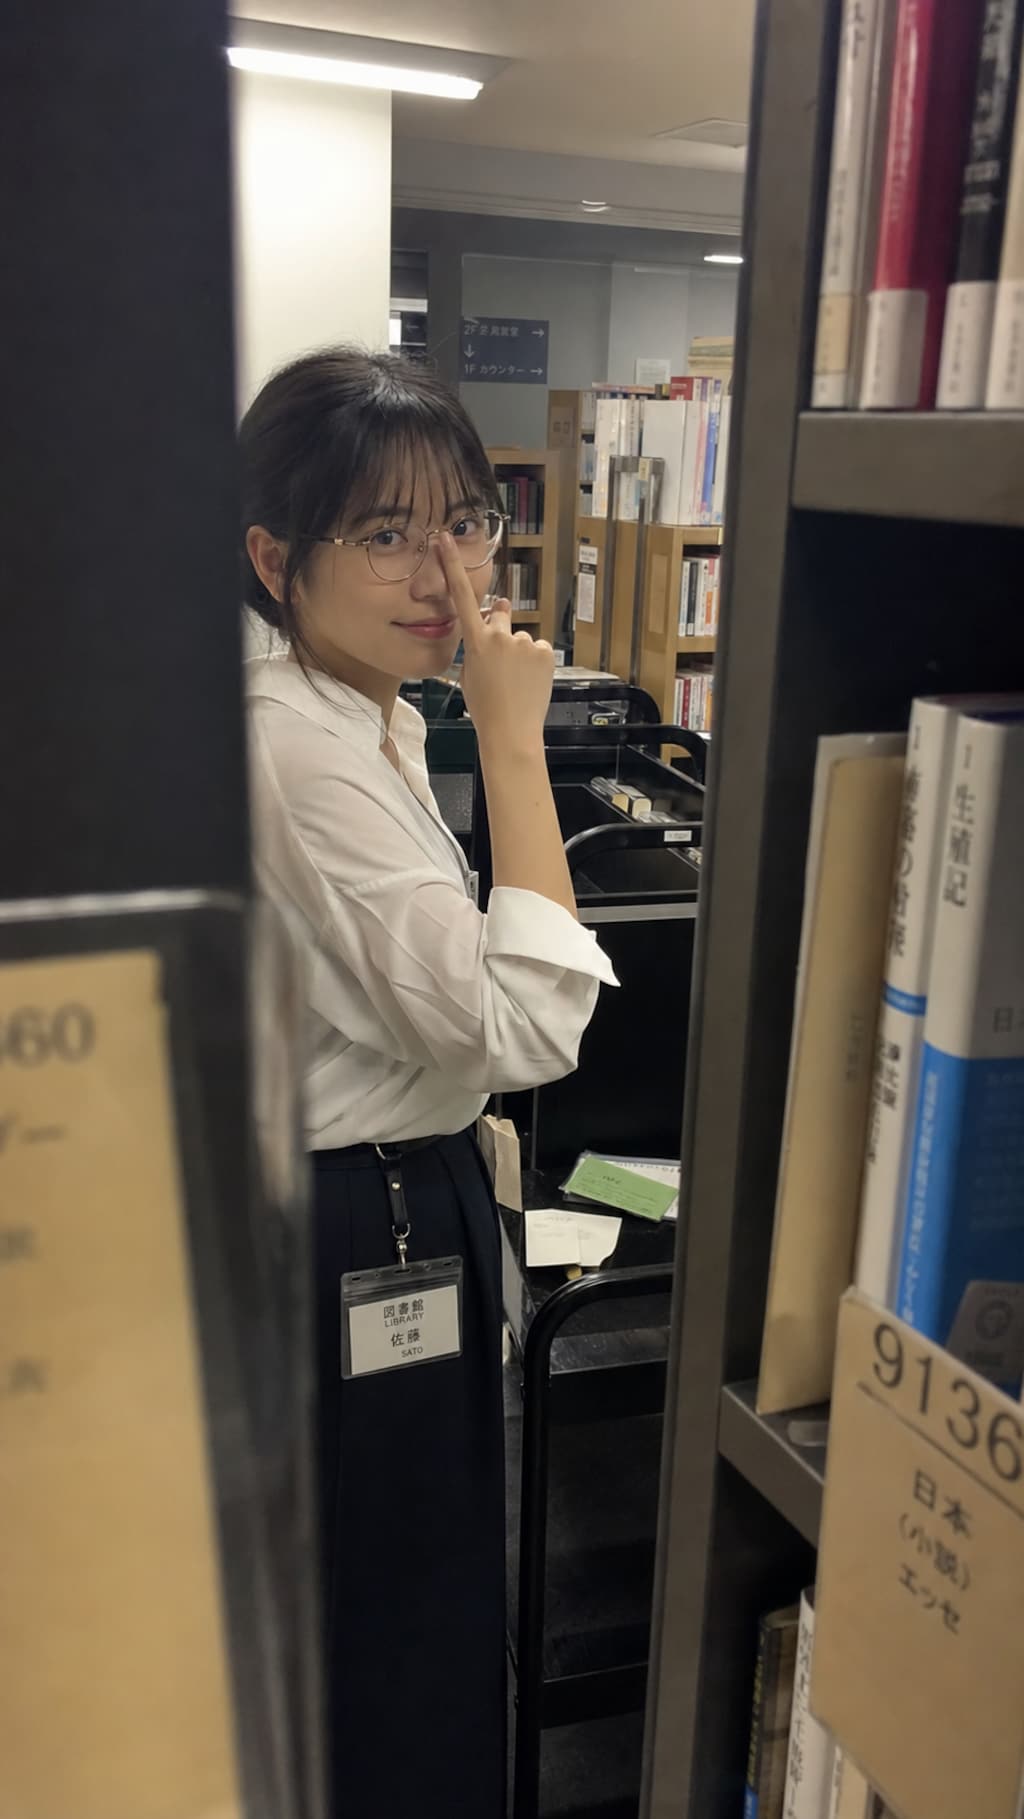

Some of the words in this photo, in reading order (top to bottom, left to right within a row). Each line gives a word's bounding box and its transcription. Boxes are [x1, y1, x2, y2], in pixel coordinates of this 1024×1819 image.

[465, 364, 477, 375] 1F
[480, 365, 525, 375] カウンター
[0, 1003, 96, 1068] 60
[383, 1299, 424, 1319] 図書館
[384, 1312, 424, 1328] LIBRARY
[390, 1328, 421, 1347] 佐藤
[401, 1346, 424, 1358] SATO
[872, 1322, 1023, 1483] 9136
[913, 1468, 972, 1540] 日本
